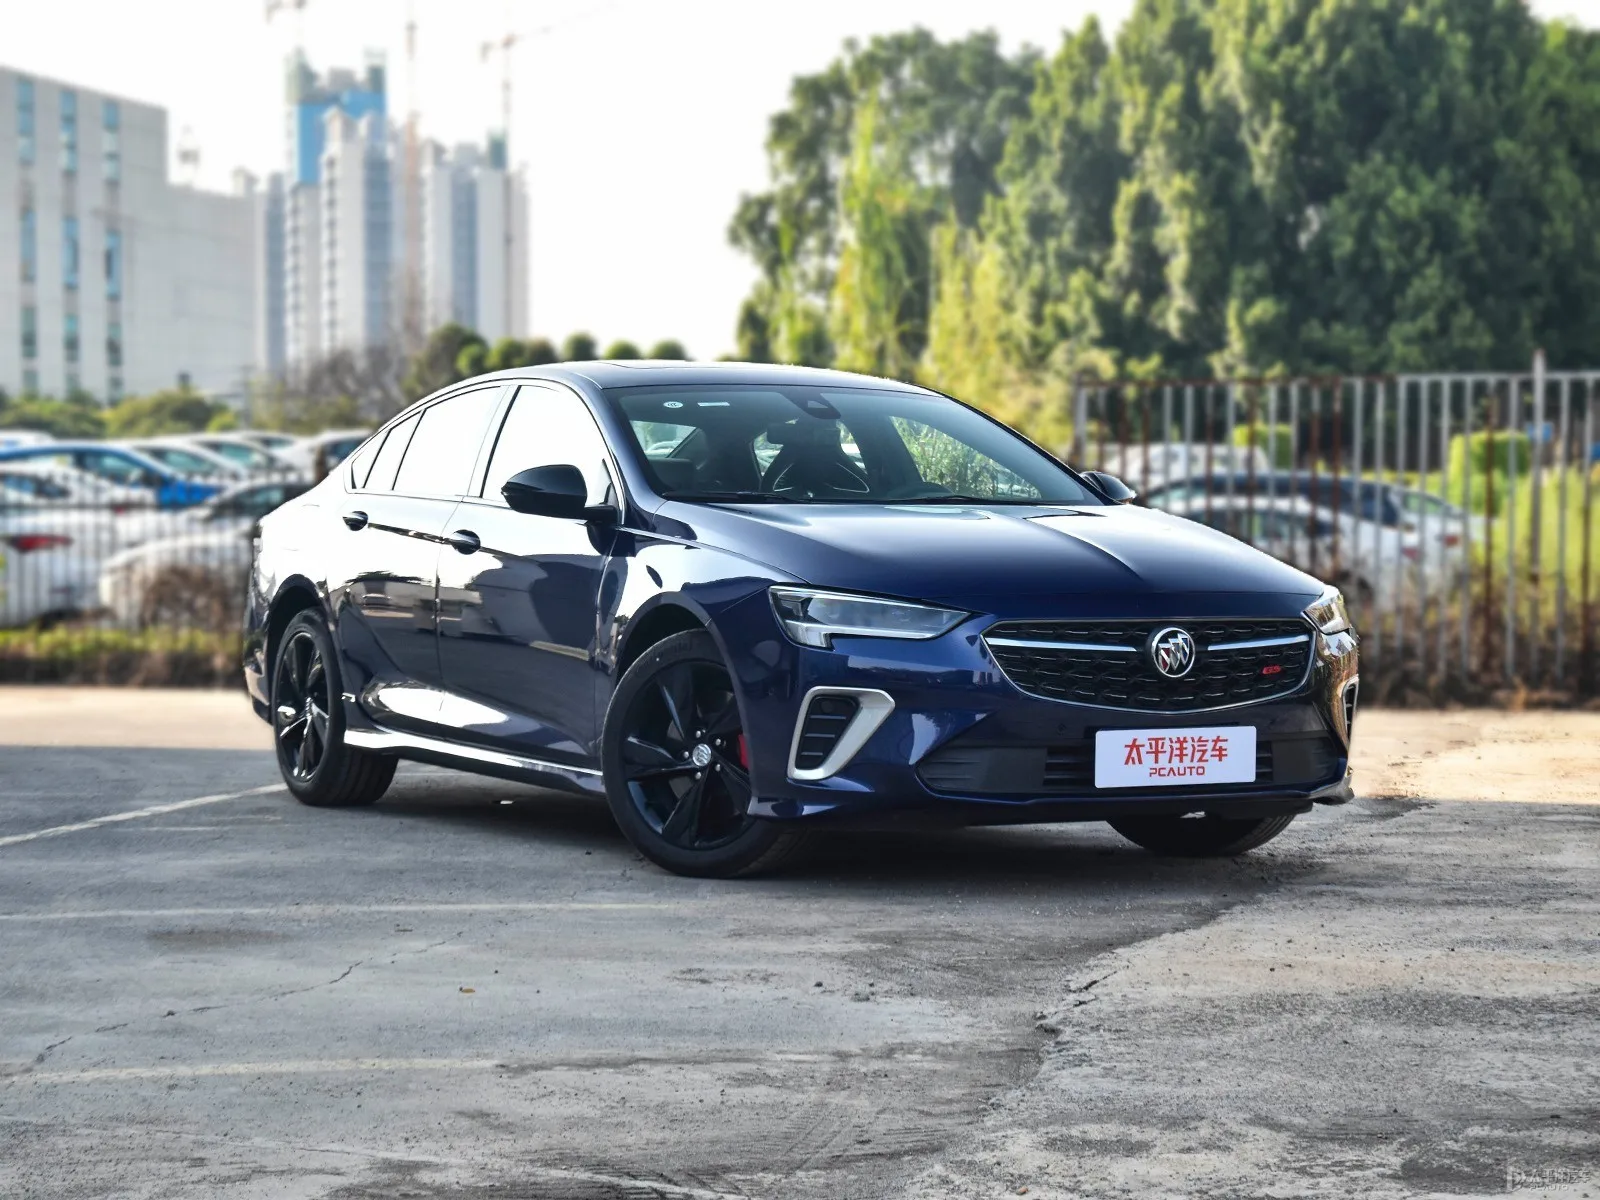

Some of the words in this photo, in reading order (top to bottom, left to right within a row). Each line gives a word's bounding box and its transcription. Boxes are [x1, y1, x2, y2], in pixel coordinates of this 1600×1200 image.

[1124, 735, 1229, 766] 太平洋汽车
[1149, 766, 1205, 777] PCAUTO
